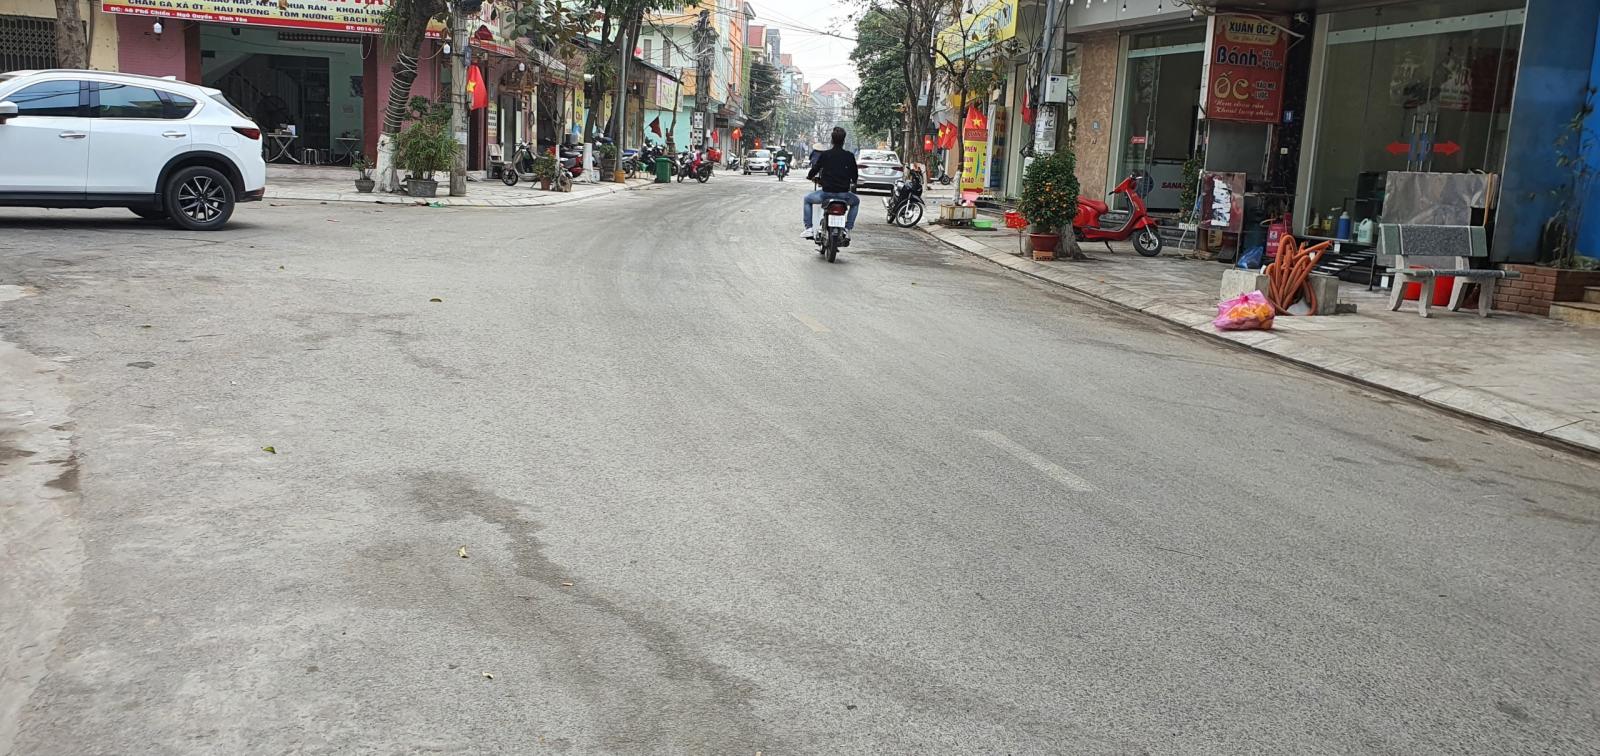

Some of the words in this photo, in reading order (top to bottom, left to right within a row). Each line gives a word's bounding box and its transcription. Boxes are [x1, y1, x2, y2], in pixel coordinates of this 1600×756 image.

[336, 6, 364, 14] KHOAI
[366, 8, 387, 16] LAN
[1228, 20, 1254, 33] XUÂN
[1256, 21, 1269, 35] ỐC
[1269, 25, 1277, 35] 2
[1215, 45, 1259, 66] Bánh
[1214, 71, 1249, 100] ỐC
[1161, 181, 1186, 189] SANA
